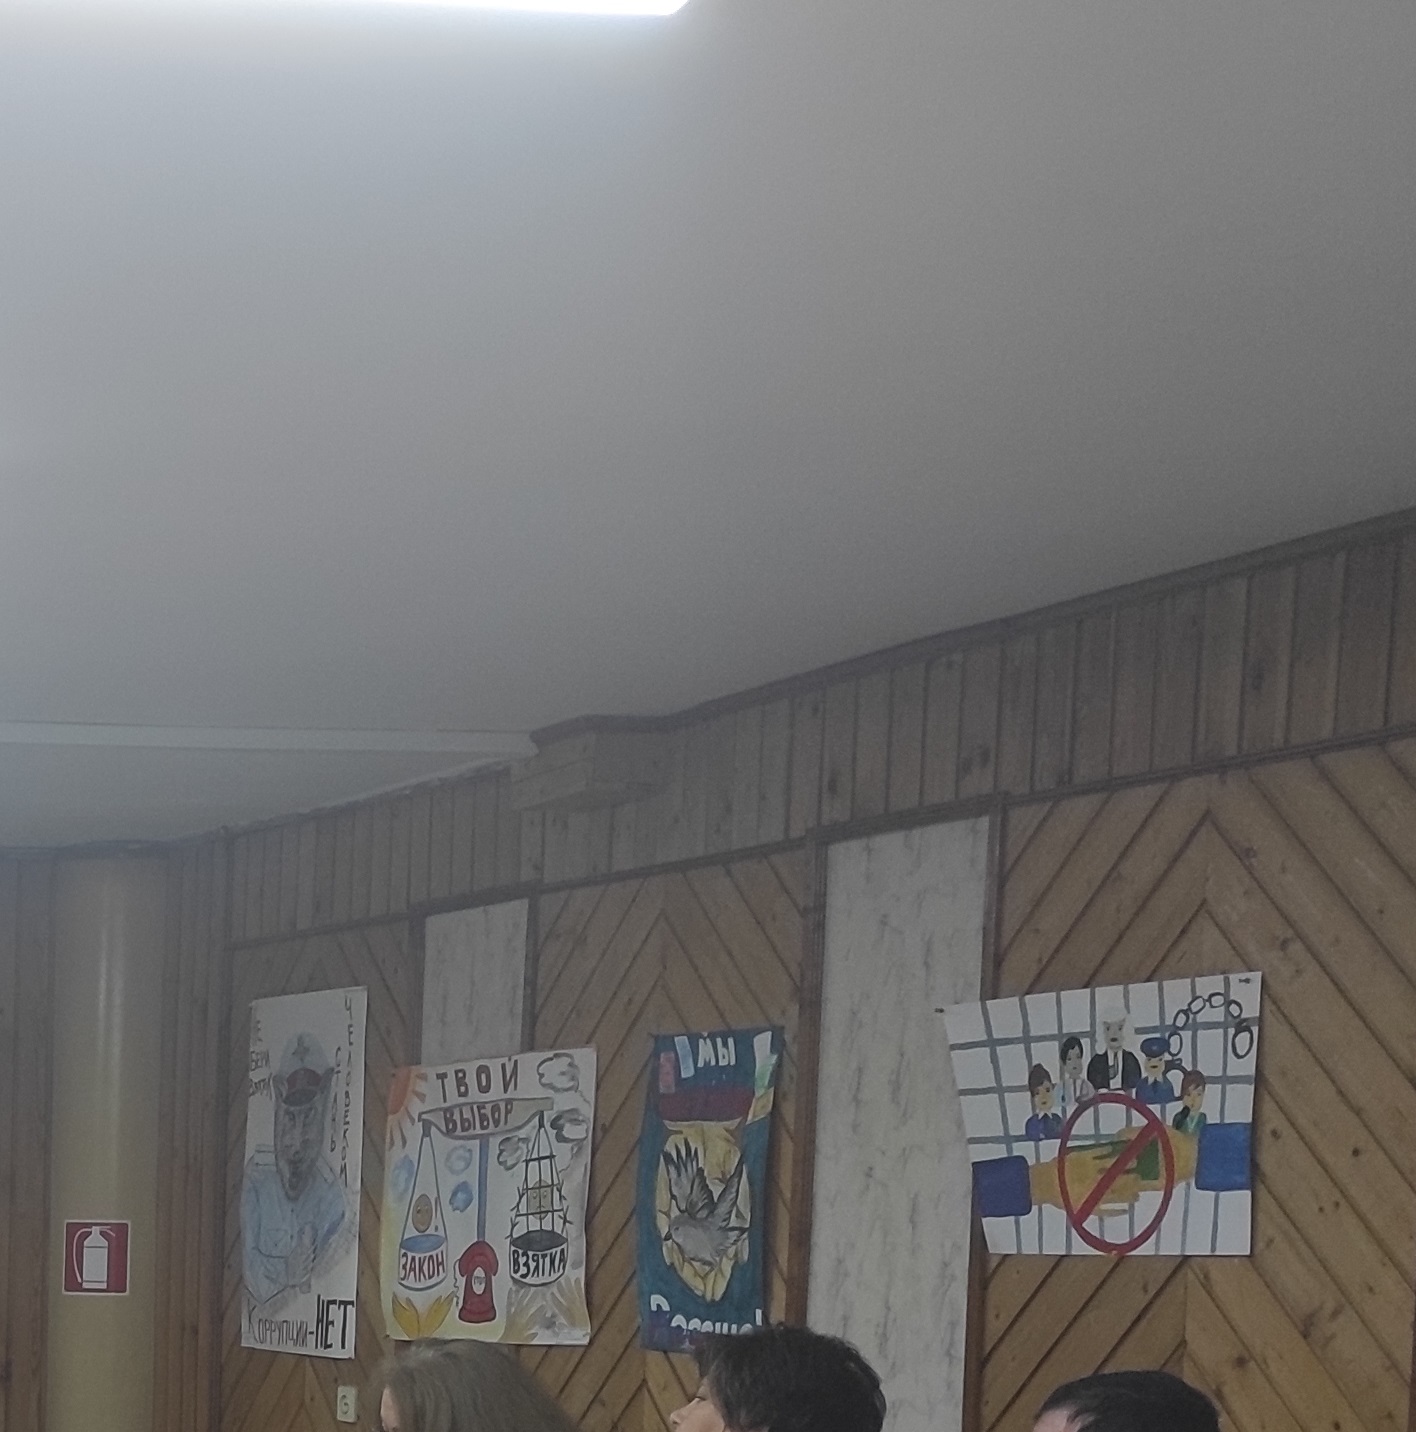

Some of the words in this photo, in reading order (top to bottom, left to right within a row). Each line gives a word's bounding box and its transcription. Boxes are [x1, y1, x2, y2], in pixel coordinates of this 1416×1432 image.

[435, 1054, 519, 1104] ТВОЙ
[442, 1101, 515, 1136] ВЫБОР
[399, 1250, 446, 1282] ЗАКОН
[511, 1247, 567, 1280] ВЗЯТКА
